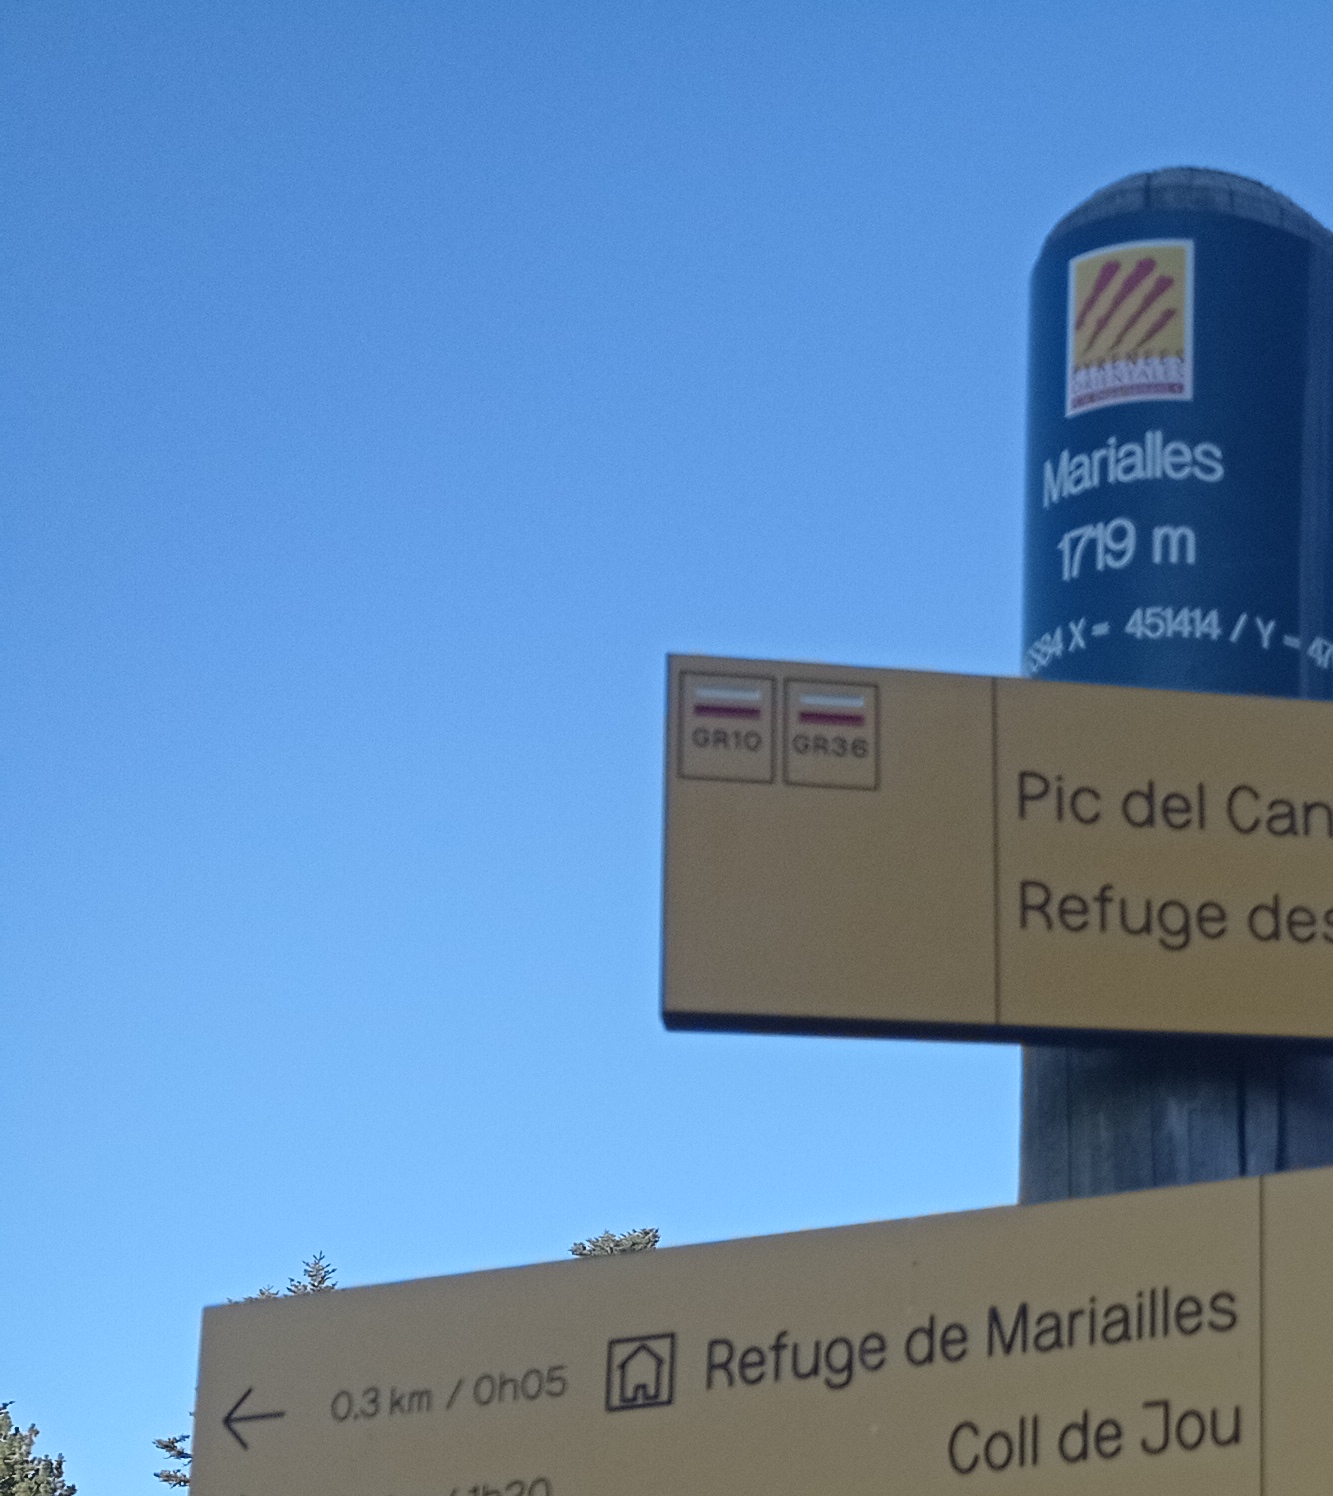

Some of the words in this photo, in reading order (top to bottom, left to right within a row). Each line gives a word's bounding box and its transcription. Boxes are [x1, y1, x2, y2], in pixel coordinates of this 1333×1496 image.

[1043, 430, 1224, 508] Marialles
[1056, 517, 1136, 581] 1719
[1153, 523, 1197, 564] m
[1068, 616, 1088, 652] X
[1124, 605, 1222, 641] 451414
[1229, 611, 1248, 643] /
[1255, 616, 1277, 650] Y
[691, 726, 763, 754] GR10
[792, 732, 870, 759] GR36
[1018, 770, 1100, 824] Pic
[1121, 780, 1206, 831] del
[1019, 879, 1228, 951] Refuge
[705, 1330, 888, 1391] Refuge
[904, 1313, 969, 1367] de
[986, 1285, 1239, 1358] Mariailles
[329, 1386, 382, 1423] 0.3
[388, 1383, 434, 1417] km
[445, 1377, 465, 1411] /
[472, 1364, 569, 1406] 0h05
[947, 1413, 1040, 1475] Coll
[1057, 1408, 1123, 1464] de
[1140, 1398, 1242, 1456] Jou
